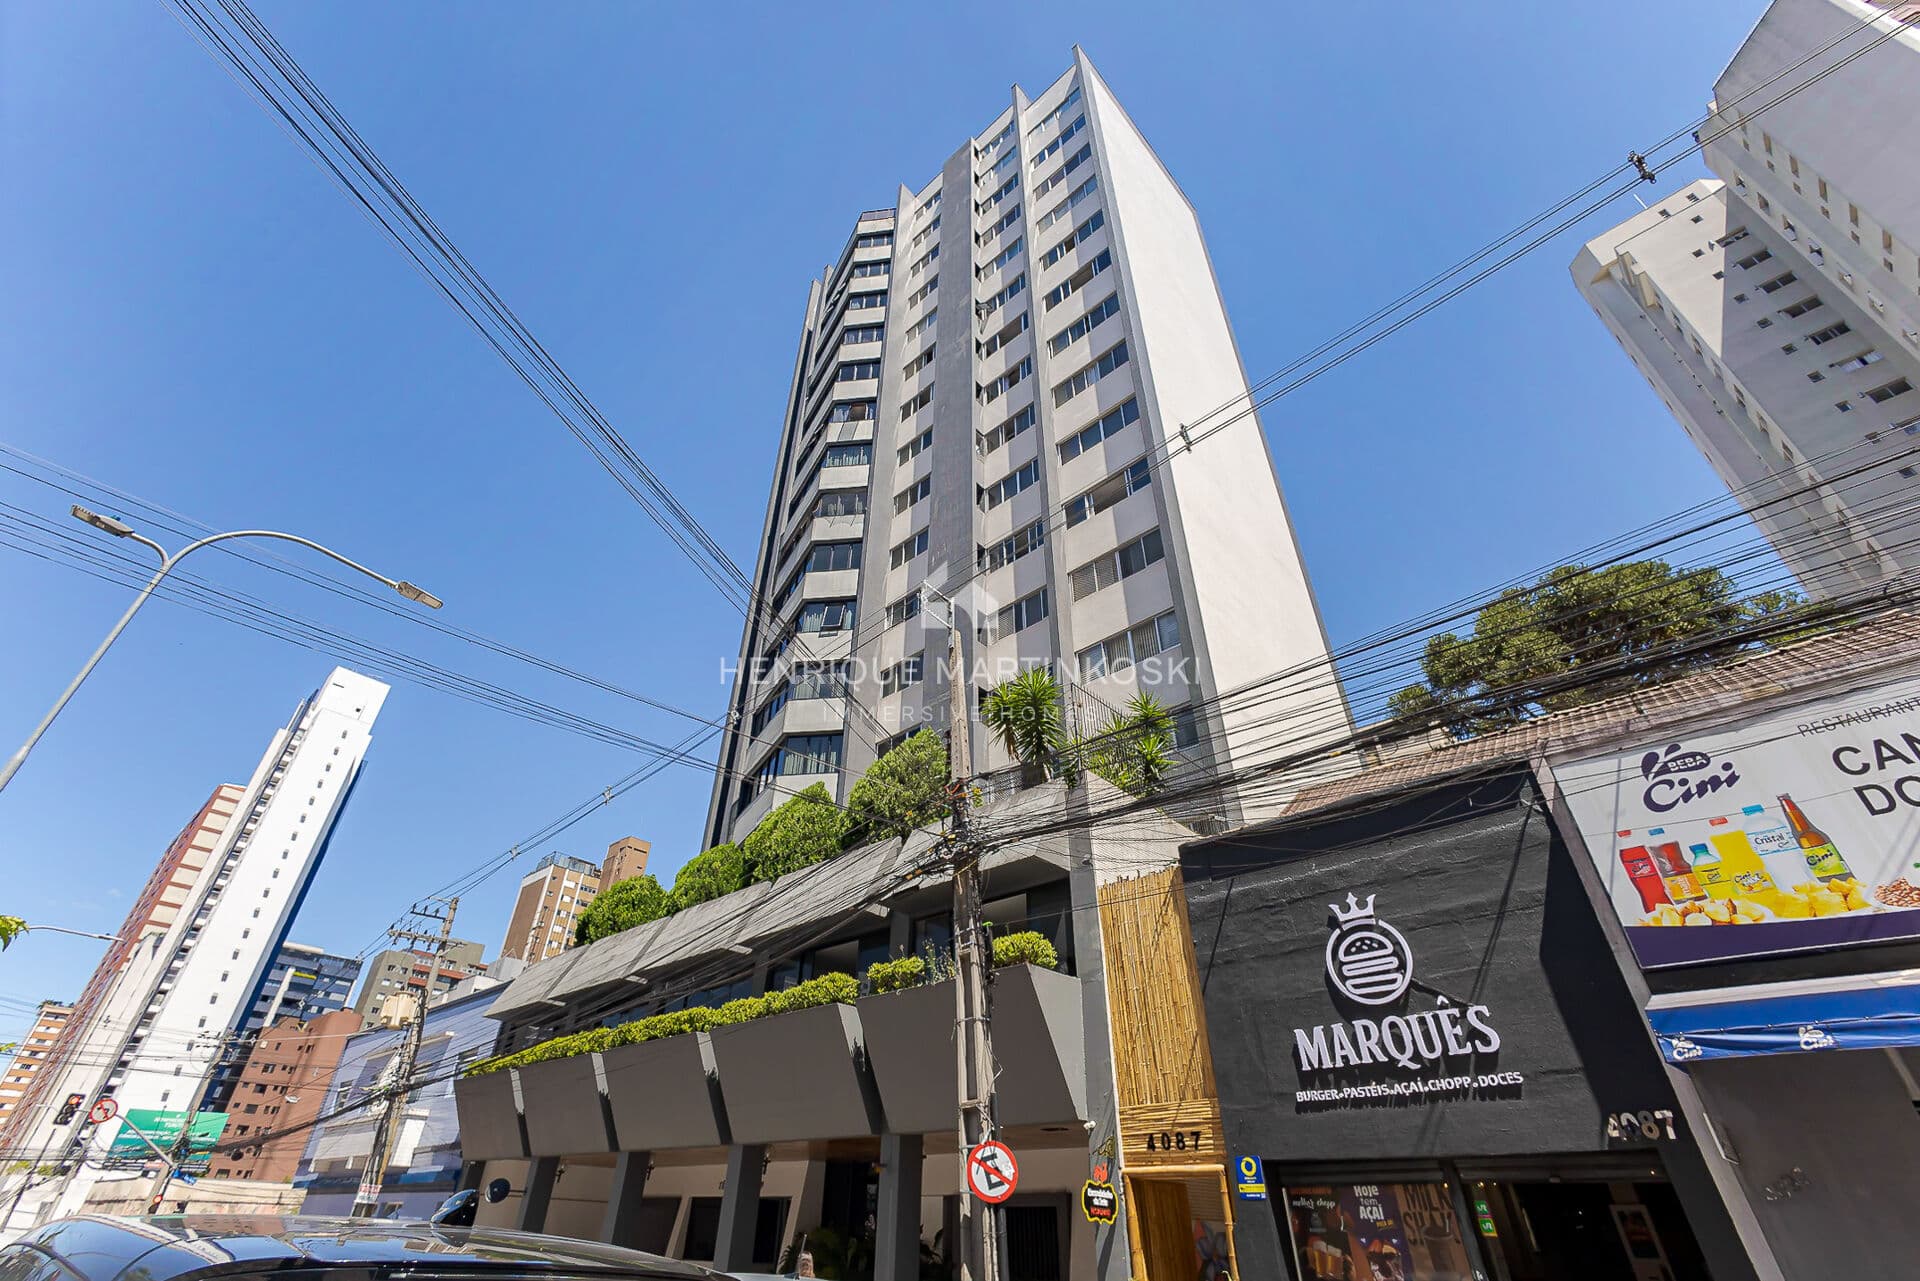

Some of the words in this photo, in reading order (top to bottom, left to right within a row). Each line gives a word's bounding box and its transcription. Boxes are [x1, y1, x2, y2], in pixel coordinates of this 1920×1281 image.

[1642, 761, 1740, 813] Cini
[1754, 832, 1785, 845] Cristal
[1806, 848, 1834, 866] Cini
[1293, 994, 1500, 1070] MARQUÊS
[1606, 1109, 1677, 1141] 4087
[1147, 1131, 1202, 1152] 4087
